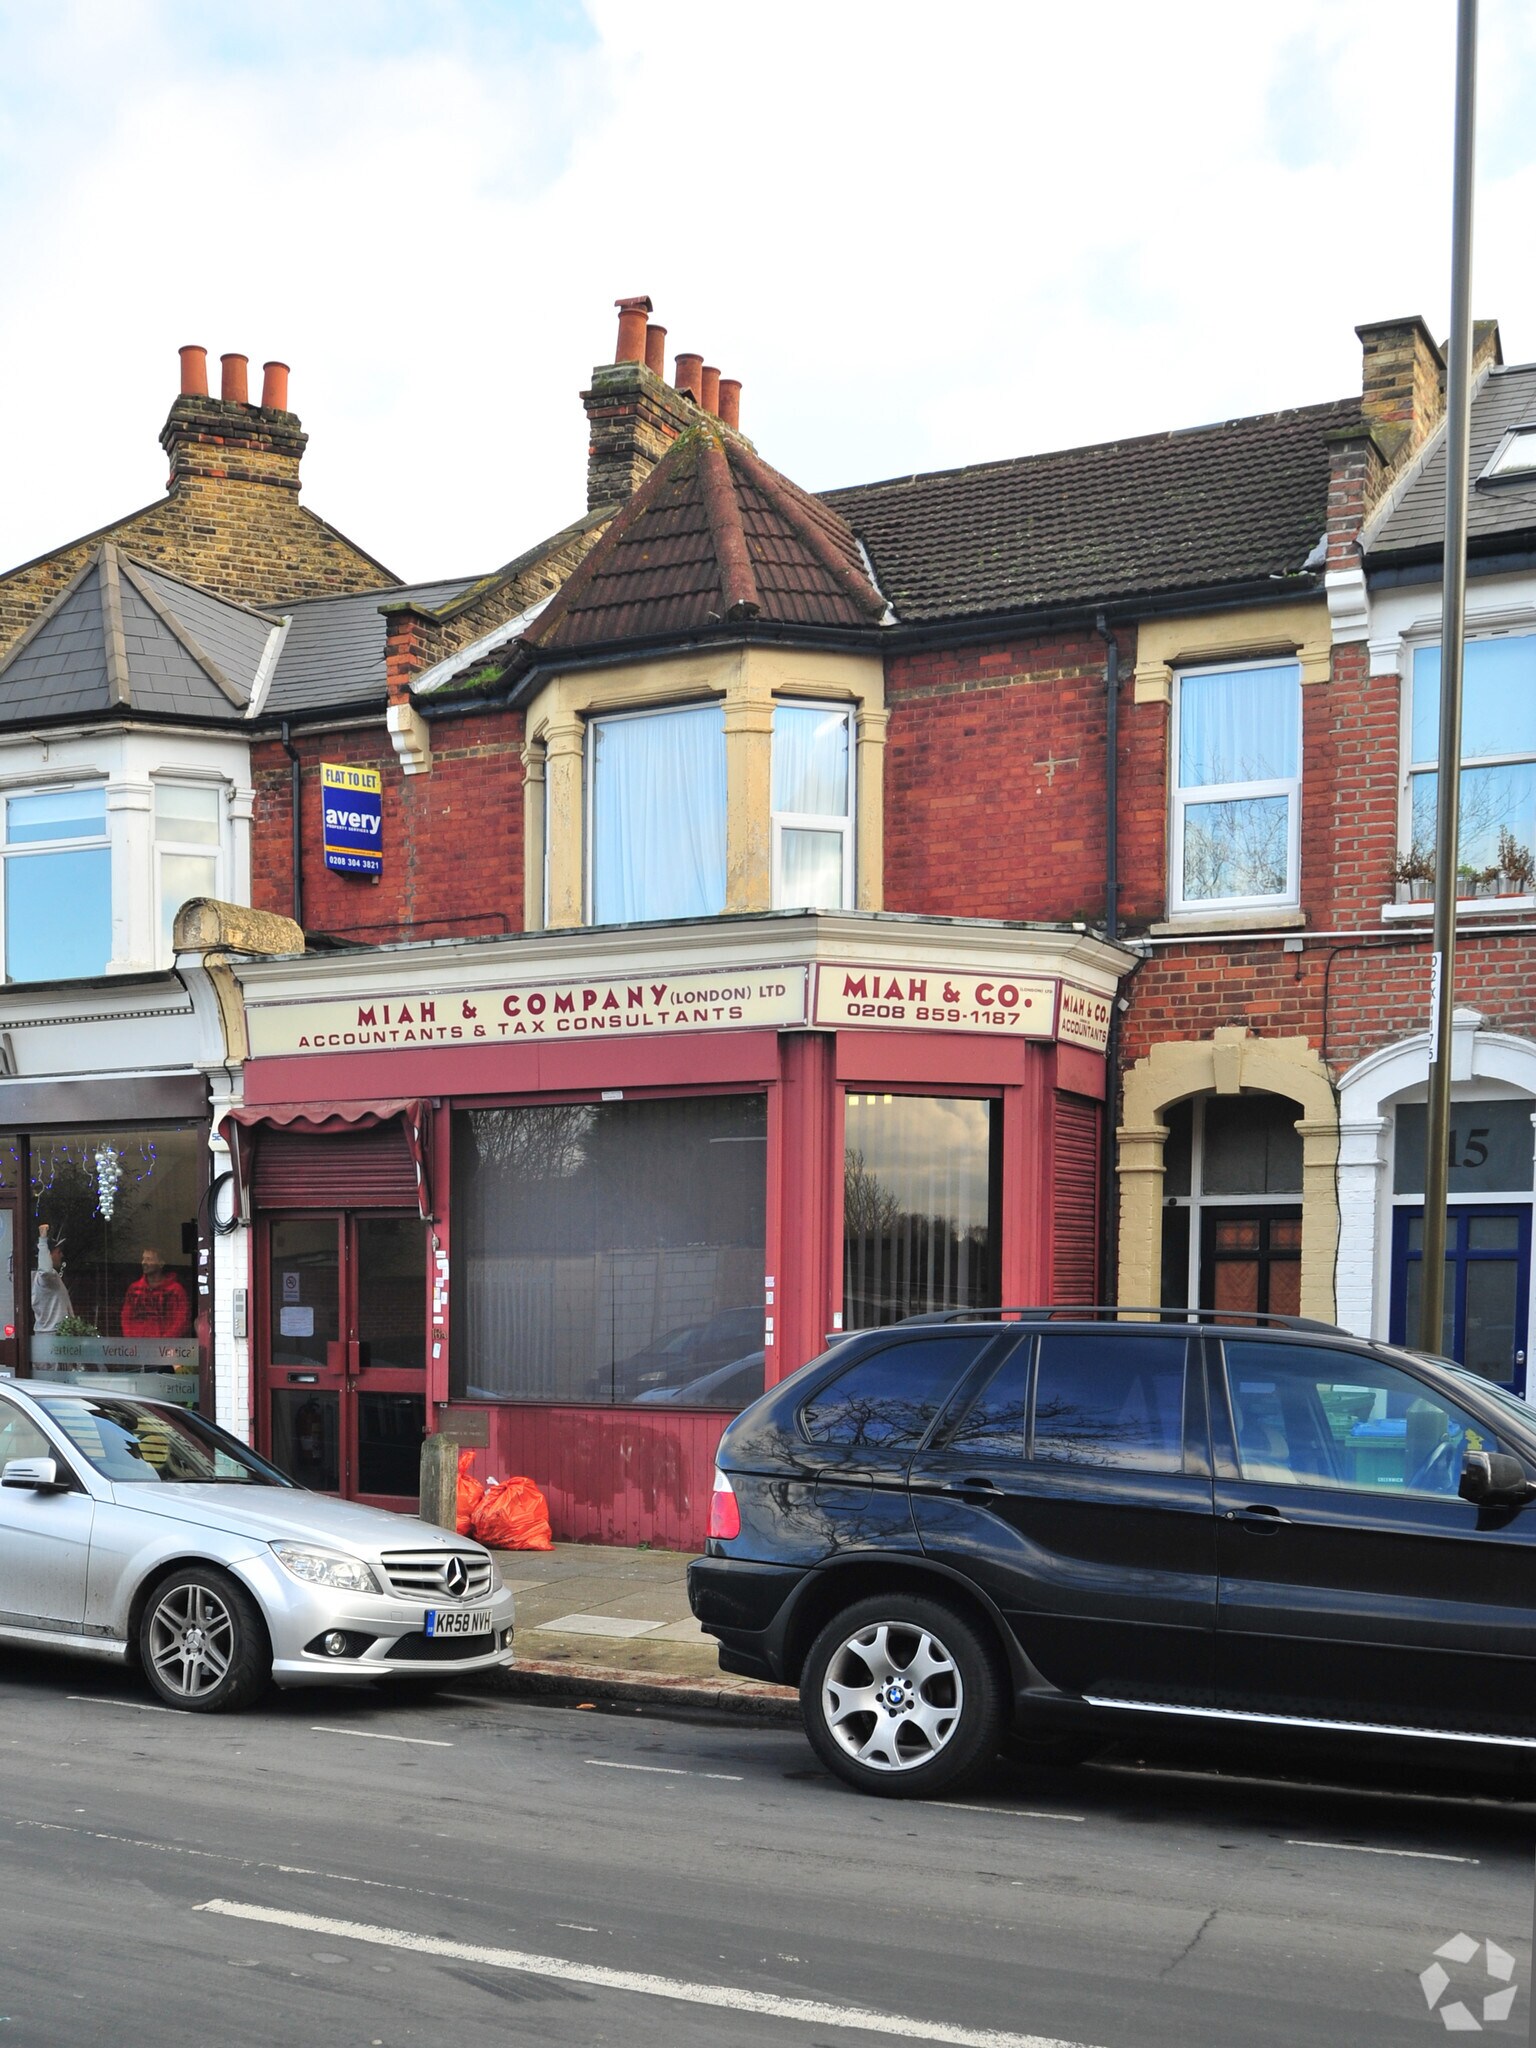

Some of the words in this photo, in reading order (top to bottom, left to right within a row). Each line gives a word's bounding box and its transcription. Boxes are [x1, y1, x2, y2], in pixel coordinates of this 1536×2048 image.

[326, 769, 345, 784] FLAT
[347, 772, 360, 786] TO
[362, 774, 376, 788] LET
[326, 808, 381, 835] avery
[329, 855, 346, 866] 0208
[347, 858, 360, 867] 304
[842, 973, 928, 1002] MIAH
[942, 981, 961, 1003] &
[975, 982, 1033, 1008] CO.
[357, 1001, 436, 1027] MIAH
[462, 999, 478, 1020] &
[503, 983, 668, 1017] COMPANY
[670, 985, 752, 1006] (LONDON)
[759, 984, 786, 999] LTD
[847, 1003, 906, 1019] 0208
[1063, 992, 1085, 1016] MIAH
[1087, 1001, 1092, 1018] &
[1095, 1003, 1109, 1024] CO.
[298, 1025, 463, 1048] ACCOUNTANTS
[473, 1024, 487, 1037] &
[498, 1020, 545, 1035] TAX
[556, 1006, 743, 1032] CONSULTANTS
[1062, 1018, 1107, 1043] ACCOUNTANTS
[1448, 1128, 1490, 1168] 15
[102, 1344, 138, 1357] Vertical
[160, 1382, 196, 1394] ertical
[436, 1614, 470, 1632] KR58
[472, 1612, 491, 1631] NVH
